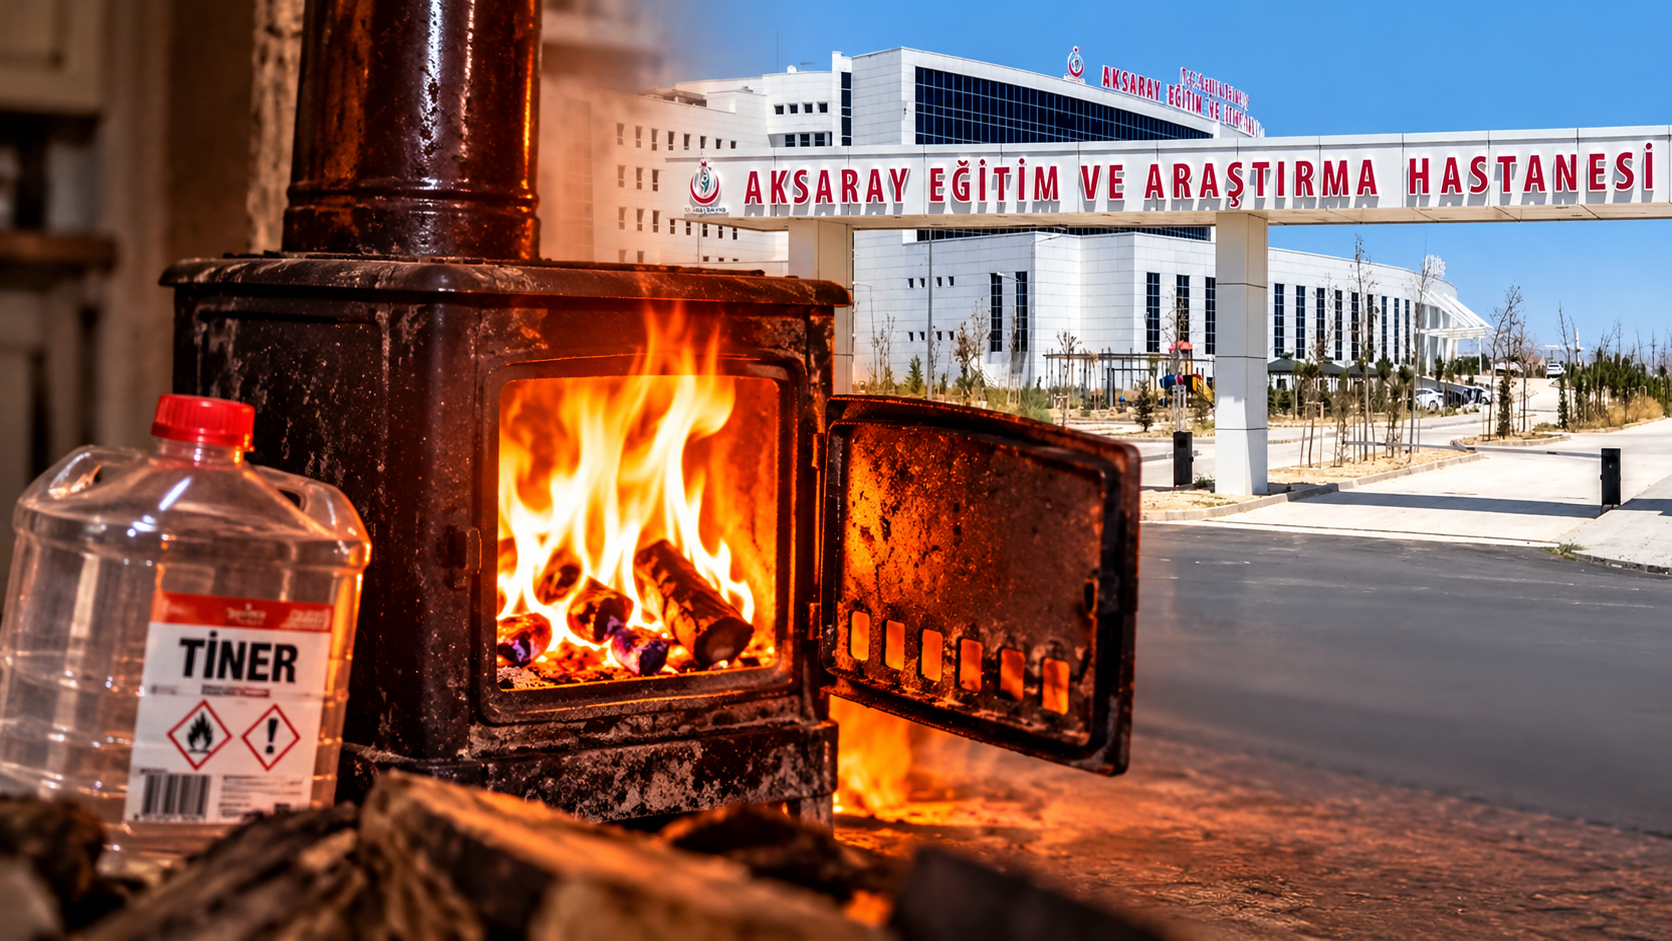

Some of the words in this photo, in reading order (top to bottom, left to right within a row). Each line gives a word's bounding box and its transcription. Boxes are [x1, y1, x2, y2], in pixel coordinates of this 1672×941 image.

[1102, 65, 1161, 101] AKSARAY
[744, 167, 908, 205] AKSARAY
[929, 157, 1059, 202] EĞİTİM
[1080, 164, 1125, 200] VE
[1144, 159, 1378, 208] ARAŞTIRMA
[1409, 142, 1655, 195] HASTANESİ
[179, 630, 298, 684] TİNER
